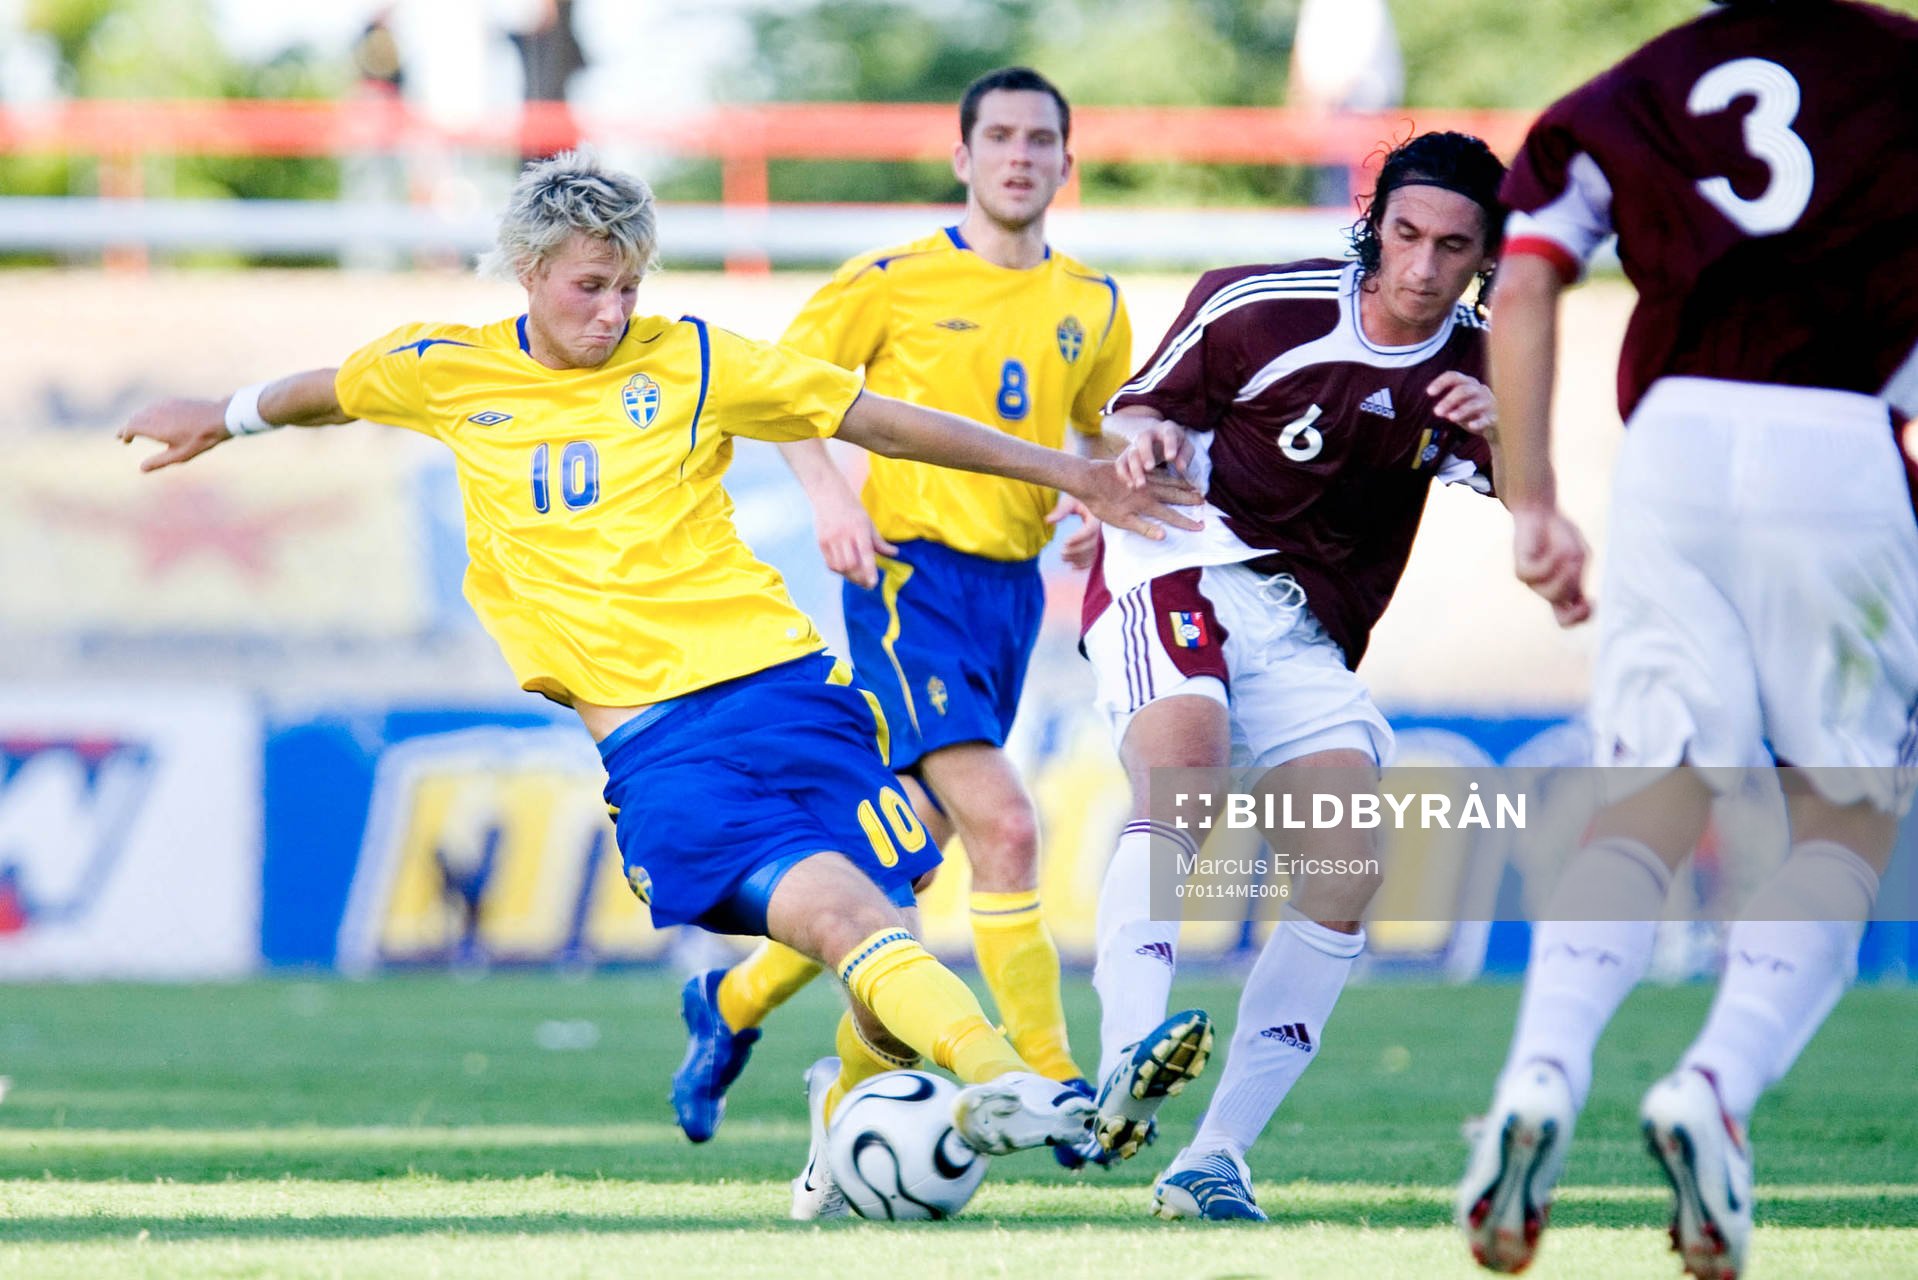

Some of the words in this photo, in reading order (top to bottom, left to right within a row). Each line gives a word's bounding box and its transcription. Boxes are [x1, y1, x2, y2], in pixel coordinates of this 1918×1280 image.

[1687, 57, 1815, 237] 3
[997, 358, 1031, 420] 8
[1360, 402, 1396, 420] adidas
[1277, 403, 1323, 462] 6
[531, 440, 600, 514] 10
[857, 785, 927, 868] 10
[1260, 1029, 1312, 1053] adidas
